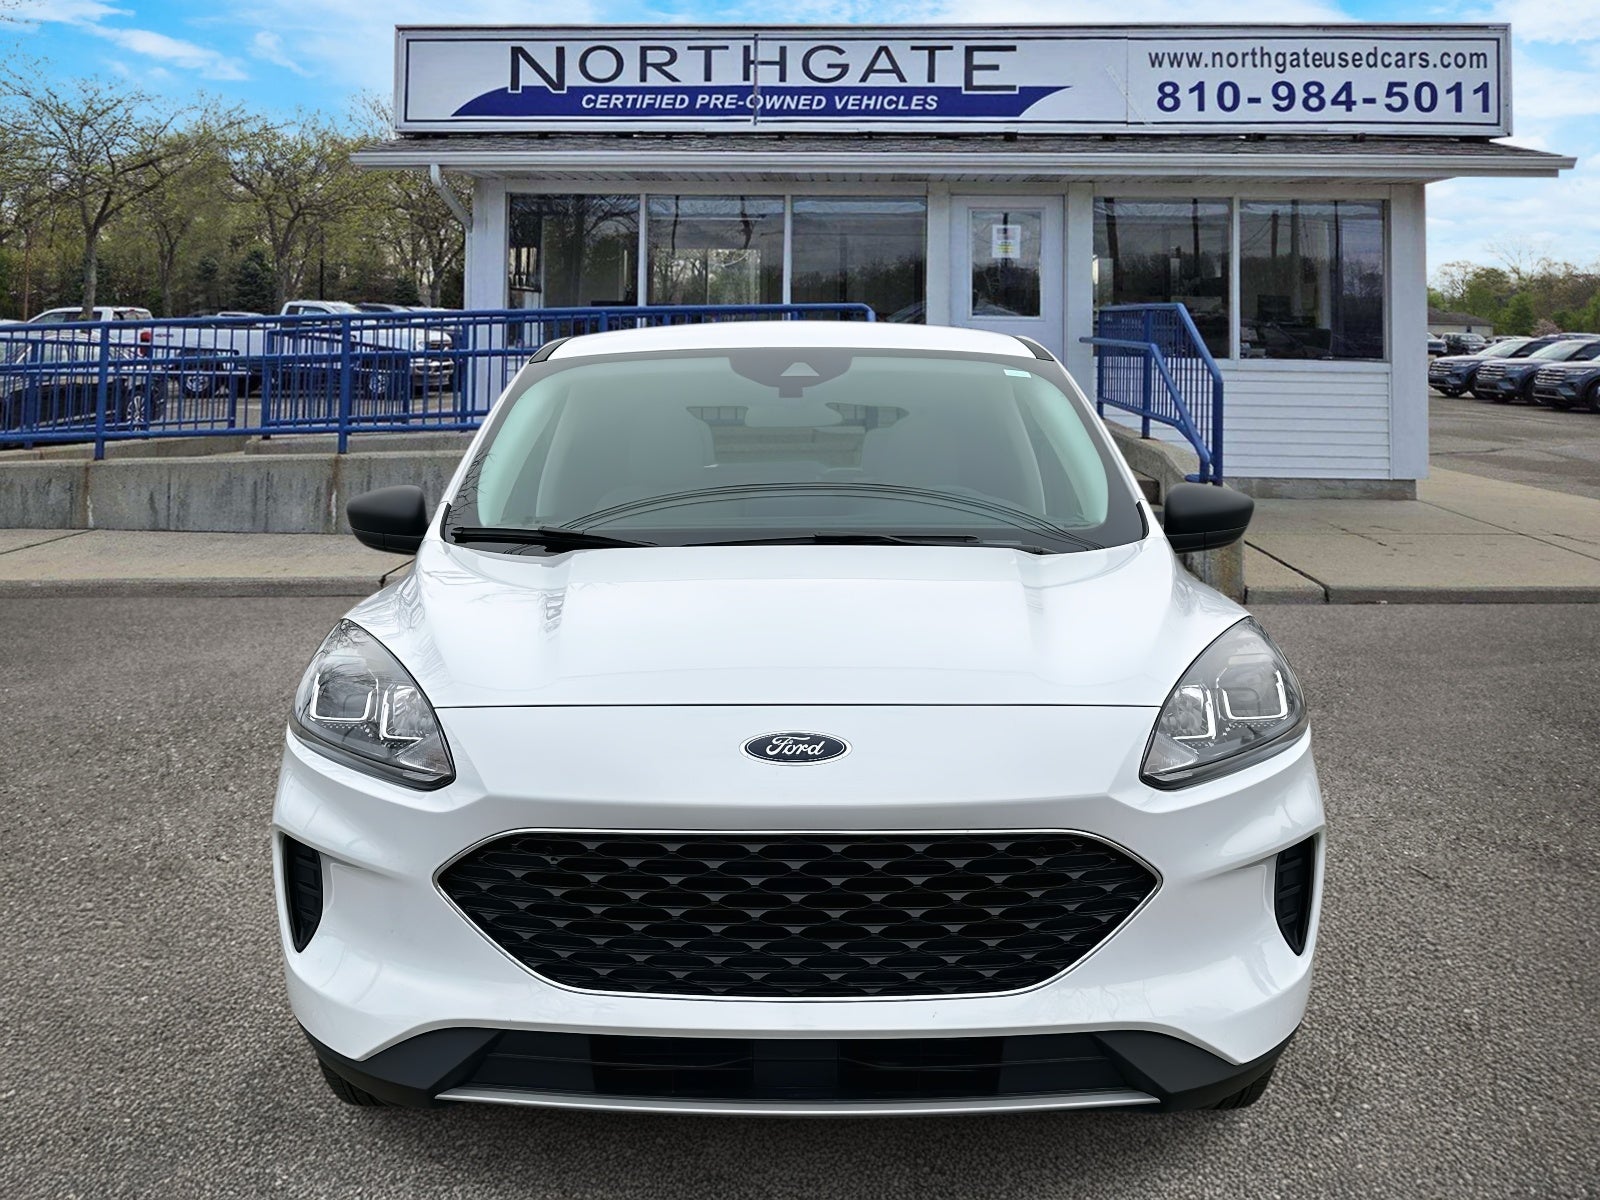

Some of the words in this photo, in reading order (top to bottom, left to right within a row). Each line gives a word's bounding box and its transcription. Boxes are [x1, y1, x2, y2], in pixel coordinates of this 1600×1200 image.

[510, 45, 1017, 92] NORTHGATE
[1148, 46, 1488, 74] www.northgateusedcars.com
[581, 94, 690, 110] CERTIFIED
[695, 94, 827, 111] PRE-OWNED
[834, 95, 939, 111] VEHICLES
[1157, 81, 1490, 113] 810-984-5011
[765, 736, 825, 756] Ford
